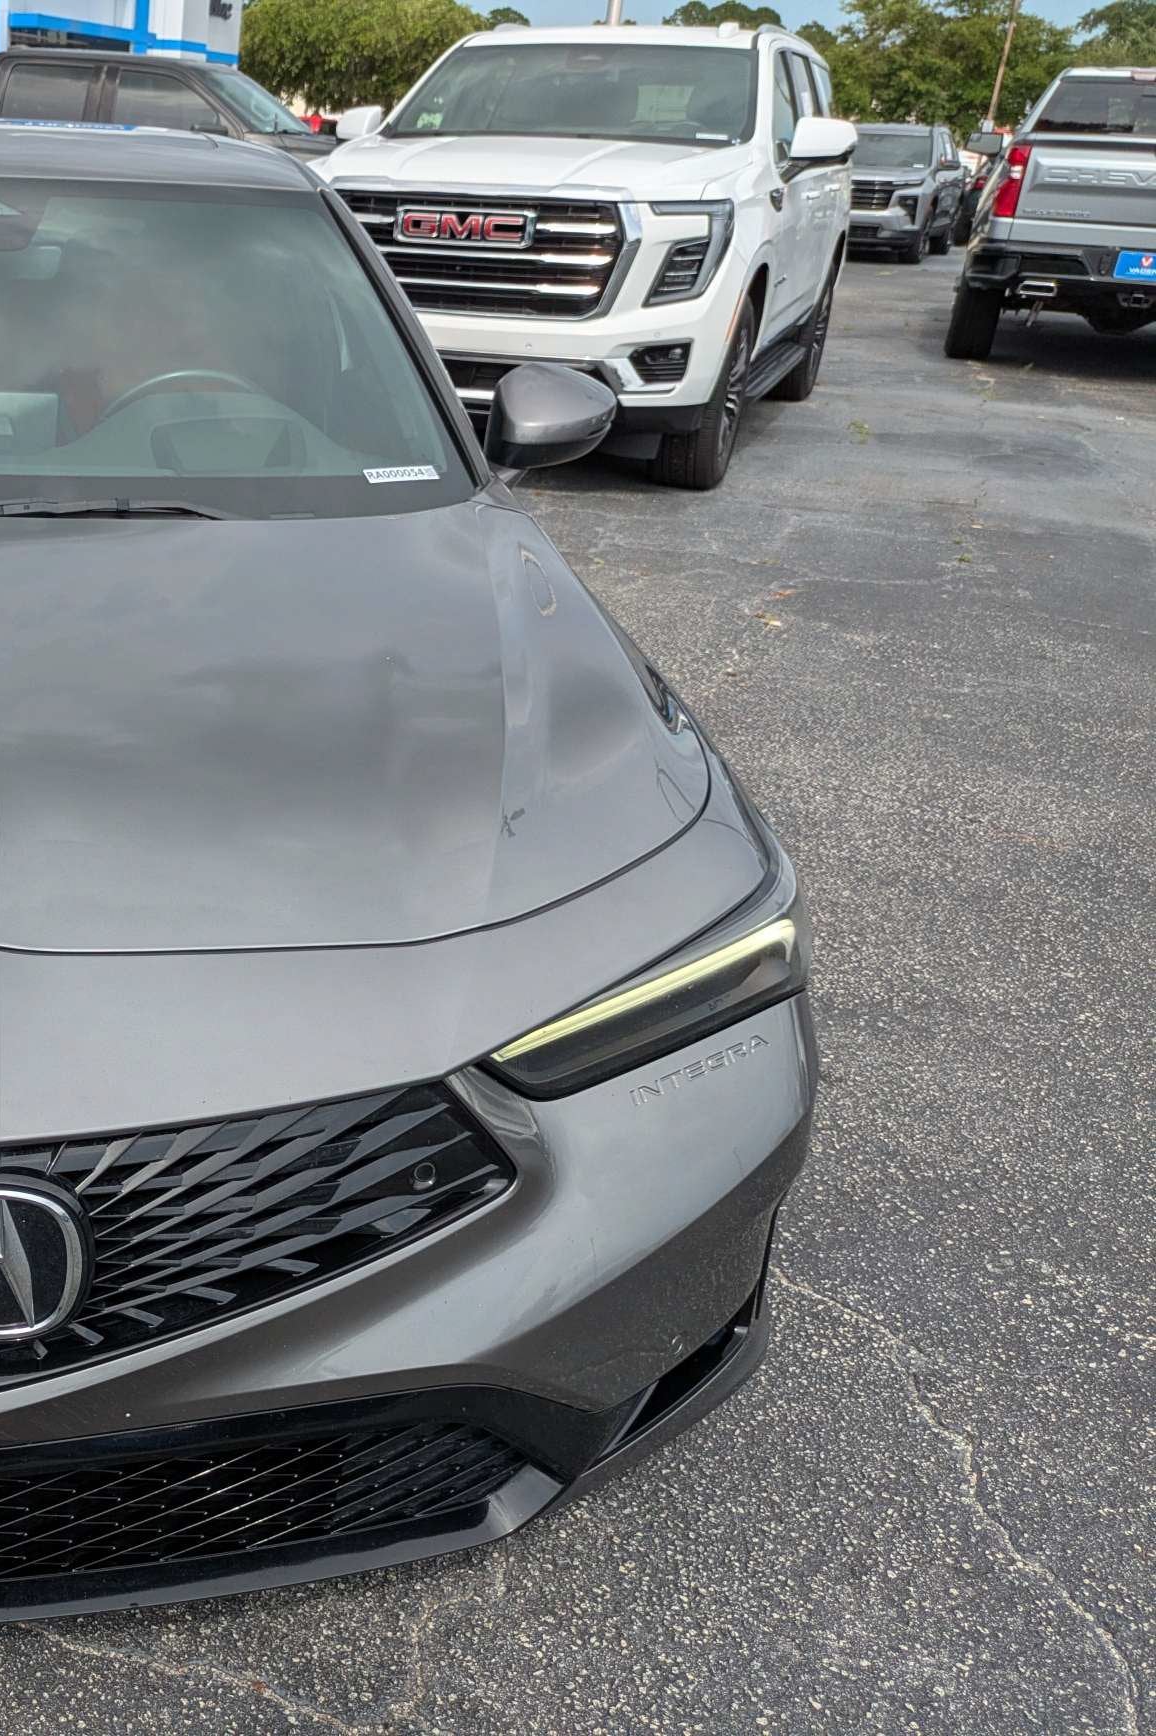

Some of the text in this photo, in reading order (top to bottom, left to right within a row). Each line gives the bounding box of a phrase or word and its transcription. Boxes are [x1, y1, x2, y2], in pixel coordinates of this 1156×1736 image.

[1043, 167, 1156, 186] CHEV
[402, 211, 525, 241] GMC
[366, 468, 425, 481] RA000054
[628, 1034, 771, 1107] INTEGRA
